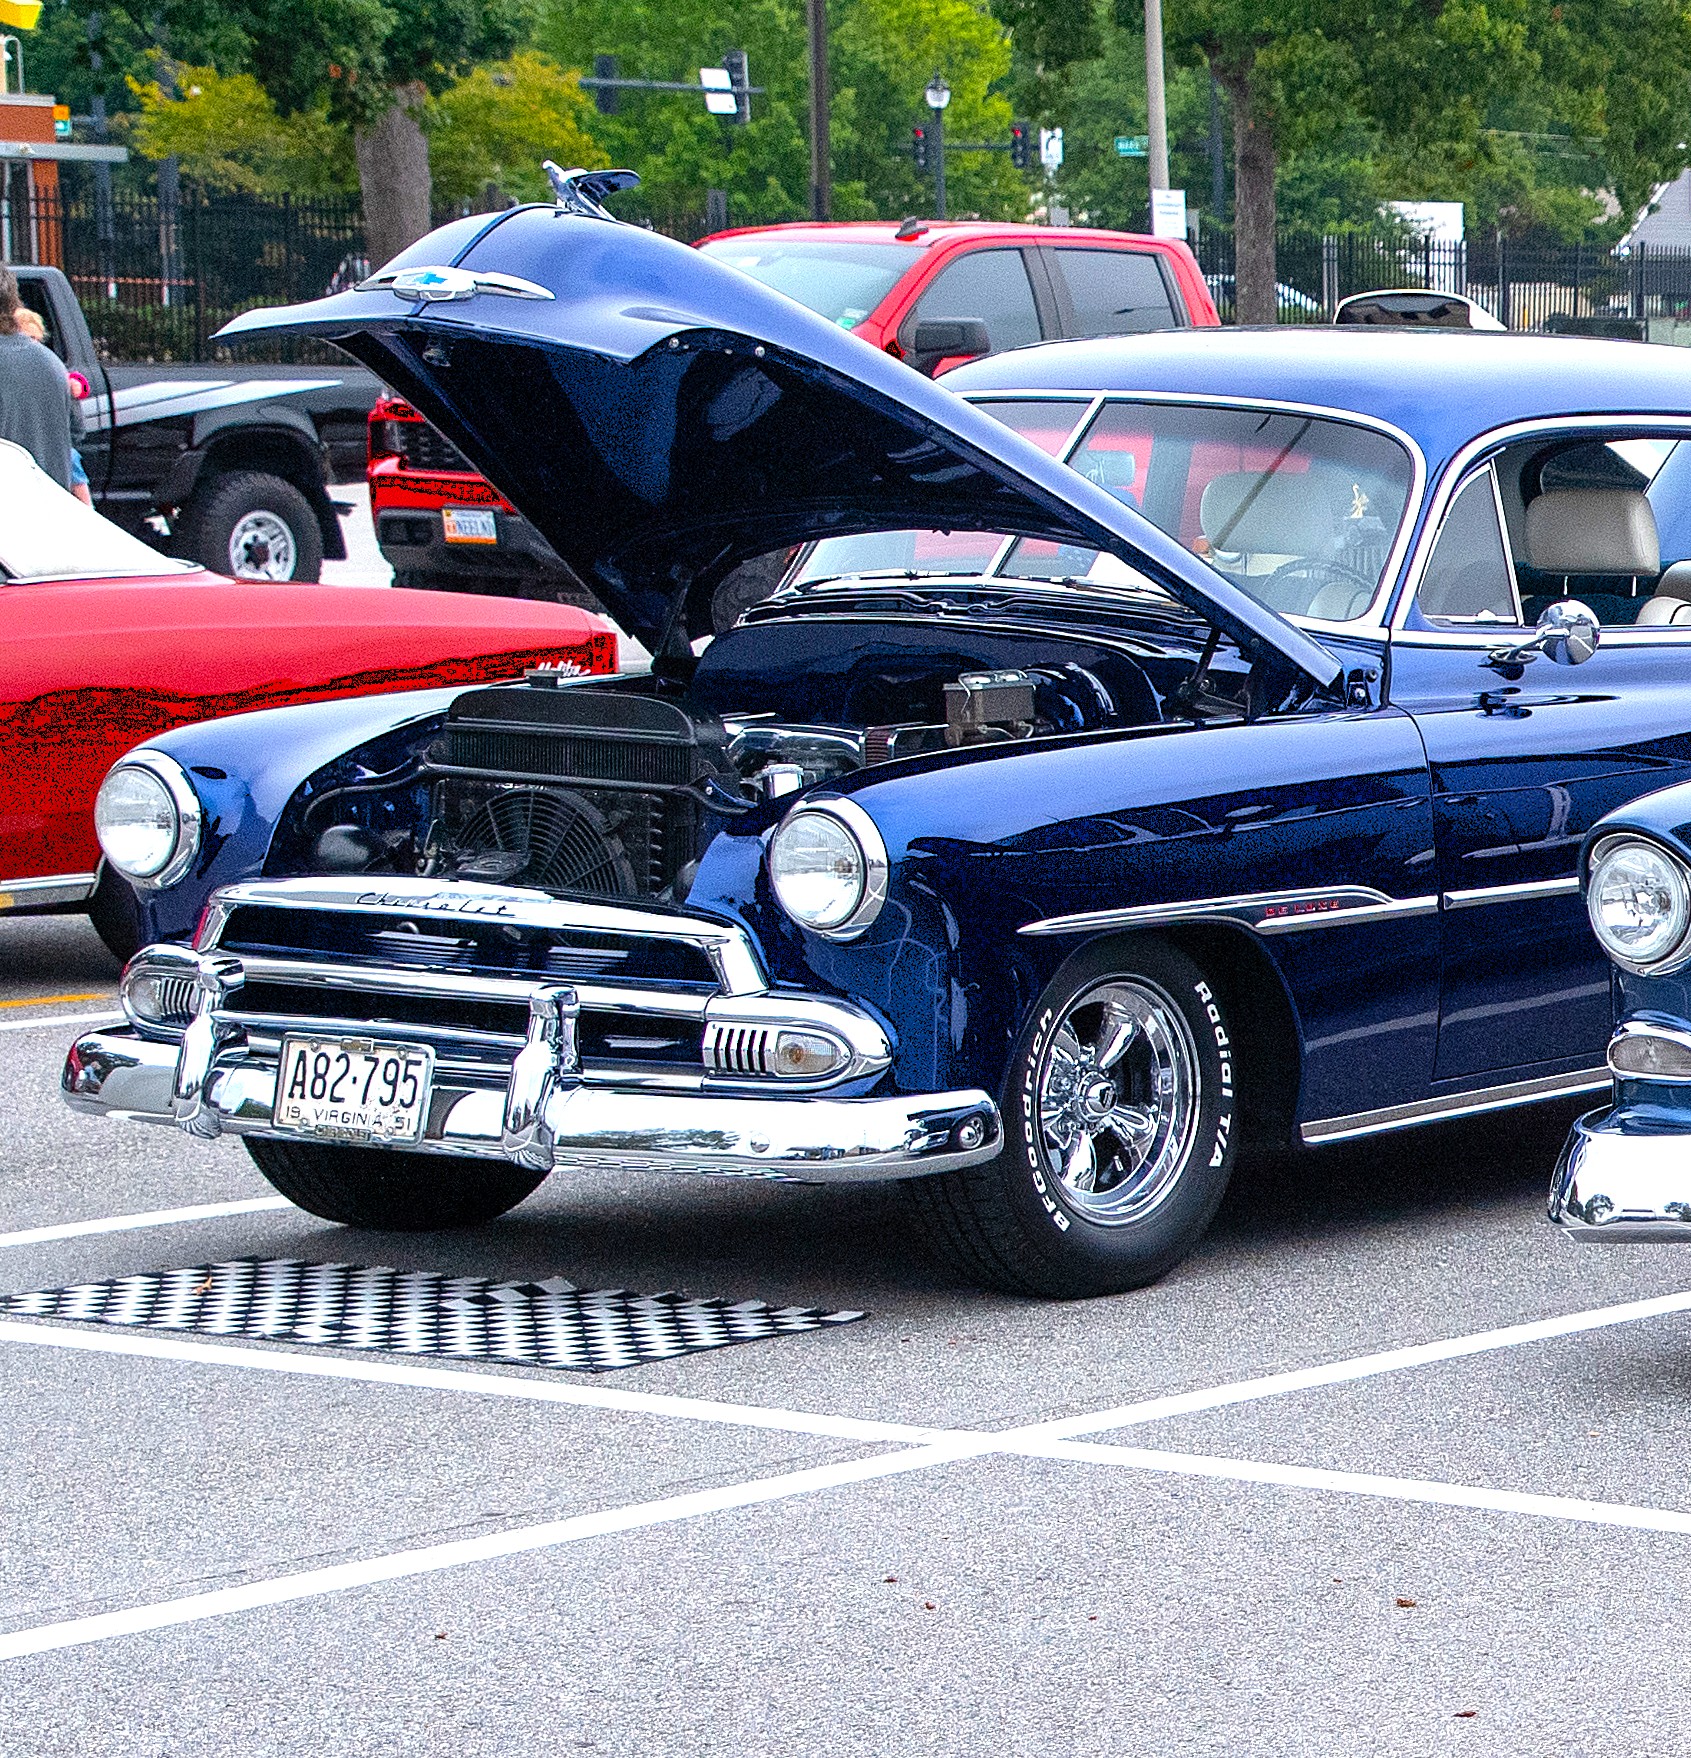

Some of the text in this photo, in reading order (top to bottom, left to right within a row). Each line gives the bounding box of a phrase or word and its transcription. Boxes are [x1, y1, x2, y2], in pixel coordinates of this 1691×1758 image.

[314, 1108, 383, 1127] VIRGINIA
[395, 1116, 412, 1131] 51
[1022, 1008, 1071, 1232] BFGoodrich
[1195, 981, 1234, 1168] Radial T/A
